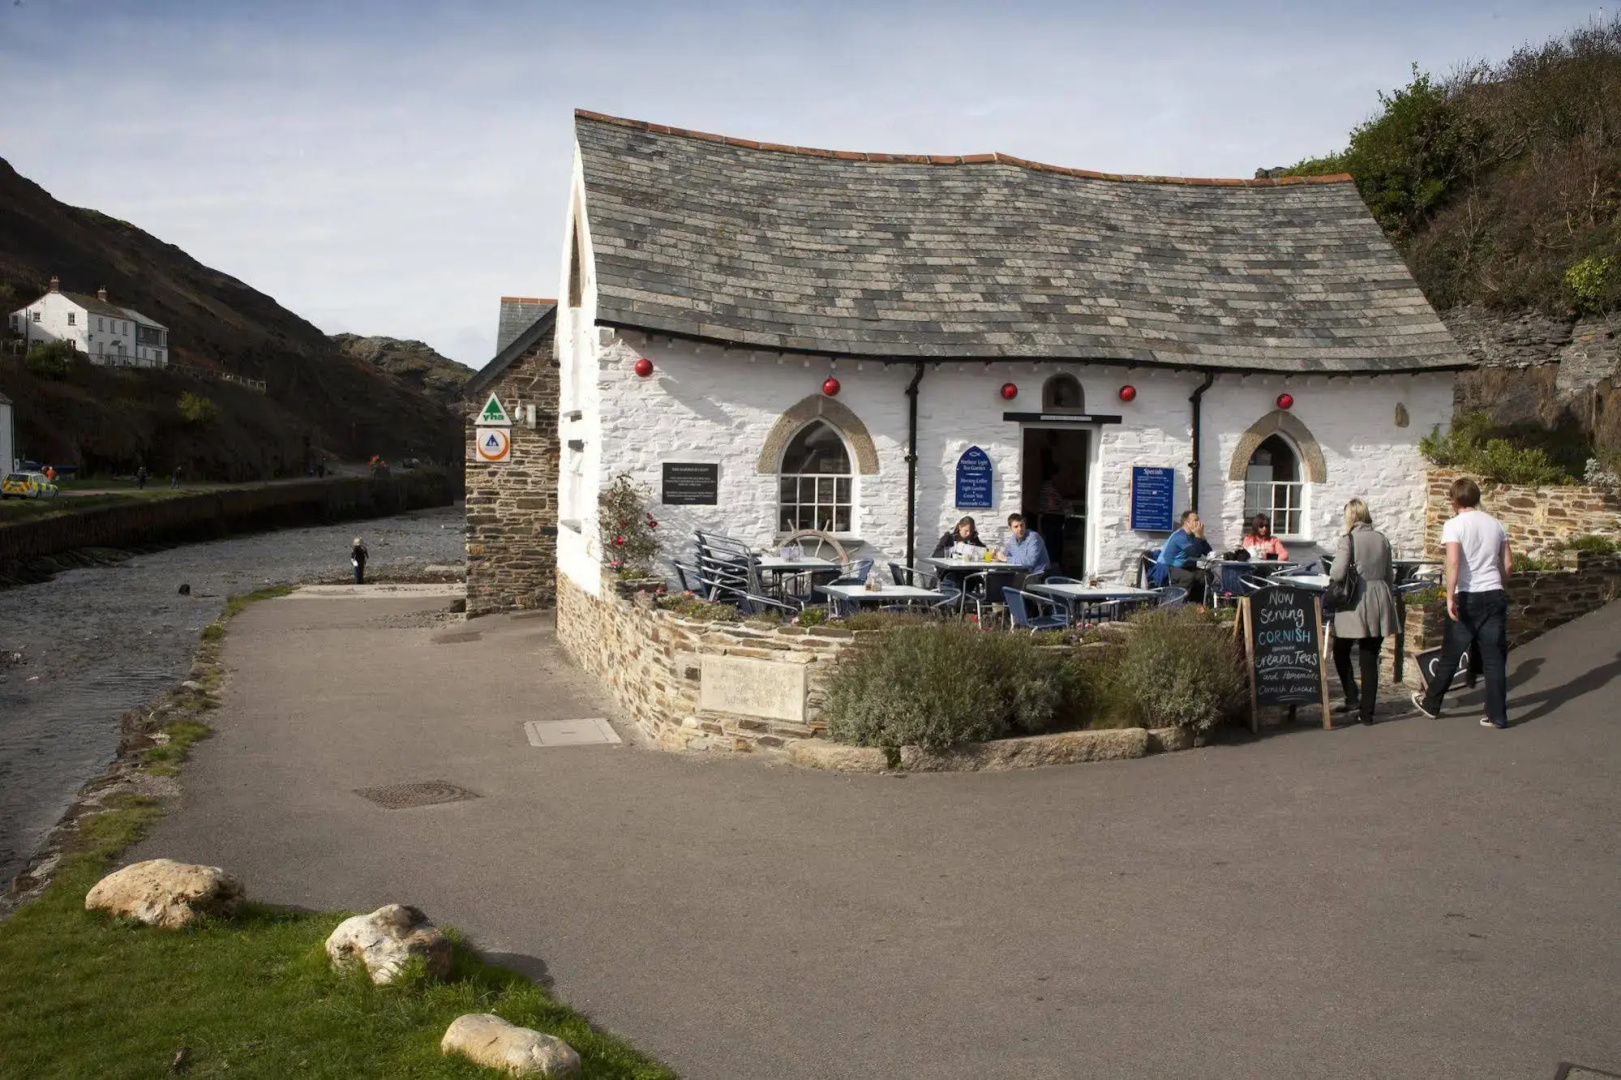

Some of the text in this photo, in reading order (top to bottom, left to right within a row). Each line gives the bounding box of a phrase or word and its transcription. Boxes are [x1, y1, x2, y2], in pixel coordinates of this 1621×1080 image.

[483, 413, 505, 421] yha
[1260, 608, 1304, 628] Serving
[1258, 628, 1311, 646] CORNISH
